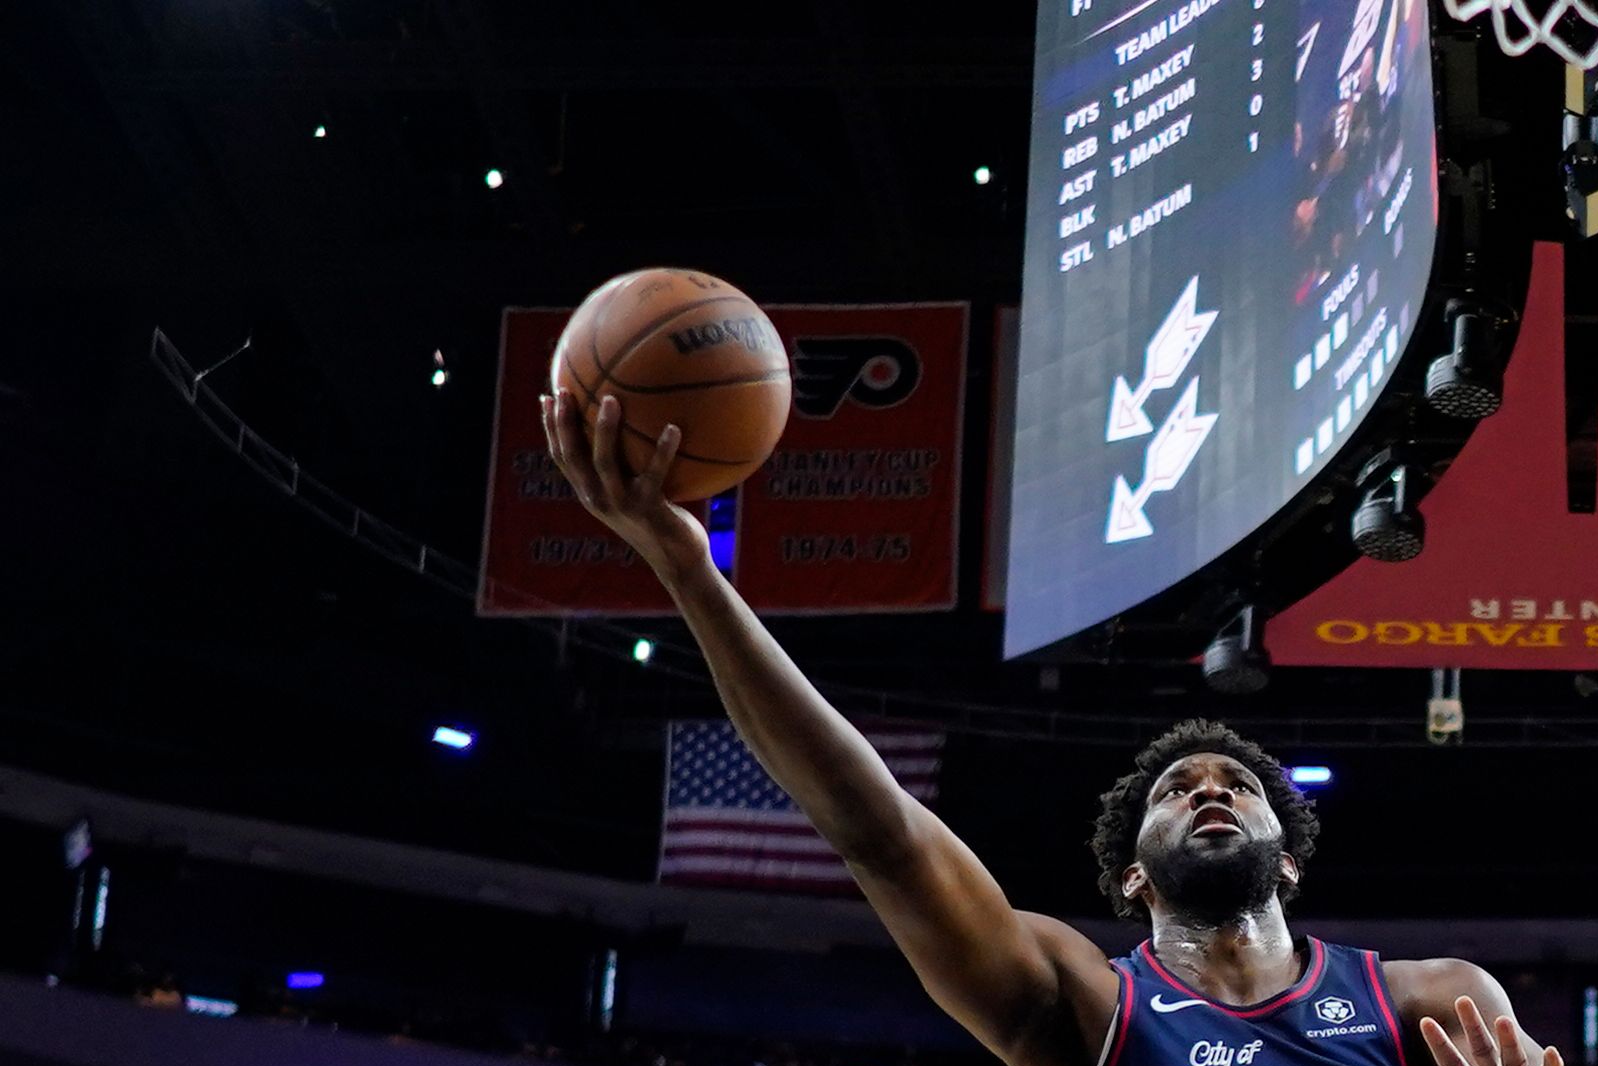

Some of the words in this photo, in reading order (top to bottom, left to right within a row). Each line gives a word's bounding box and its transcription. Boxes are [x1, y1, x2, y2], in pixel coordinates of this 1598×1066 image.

[1115, 19, 1168, 66] TEAM
[1063, 136, 1098, 169] REB
[1111, 119, 1132, 144] N.
[1134, 78, 1195, 132] BATUM
[1252, 23, 1264, 46] 2
[1064, 102, 1100, 135] PTS
[1112, 86, 1130, 109] T.
[1131, 43, 1195, 100] MAXEY
[1059, 169, 1098, 205] AST
[1110, 155, 1127, 177] T.
[1129, 113, 1192, 169] MAXEY
[1250, 59, 1264, 82] 3
[1060, 205, 1096, 238] BLK
[1249, 95, 1263, 116] 0
[1060, 241, 1094, 272] STL
[1107, 225, 1128, 249] N.
[1129, 184, 1192, 237] BATUM
[1248, 132, 1260, 153] 1
[767, 476, 932, 500] CHAMPIONS
[529, 535, 640, 567] 1973-7
[1315, 619, 1567, 647] FARGO
[1237, 1039, 1263, 1065] of
[1306, 1023, 1377, 1039] crypto.com
